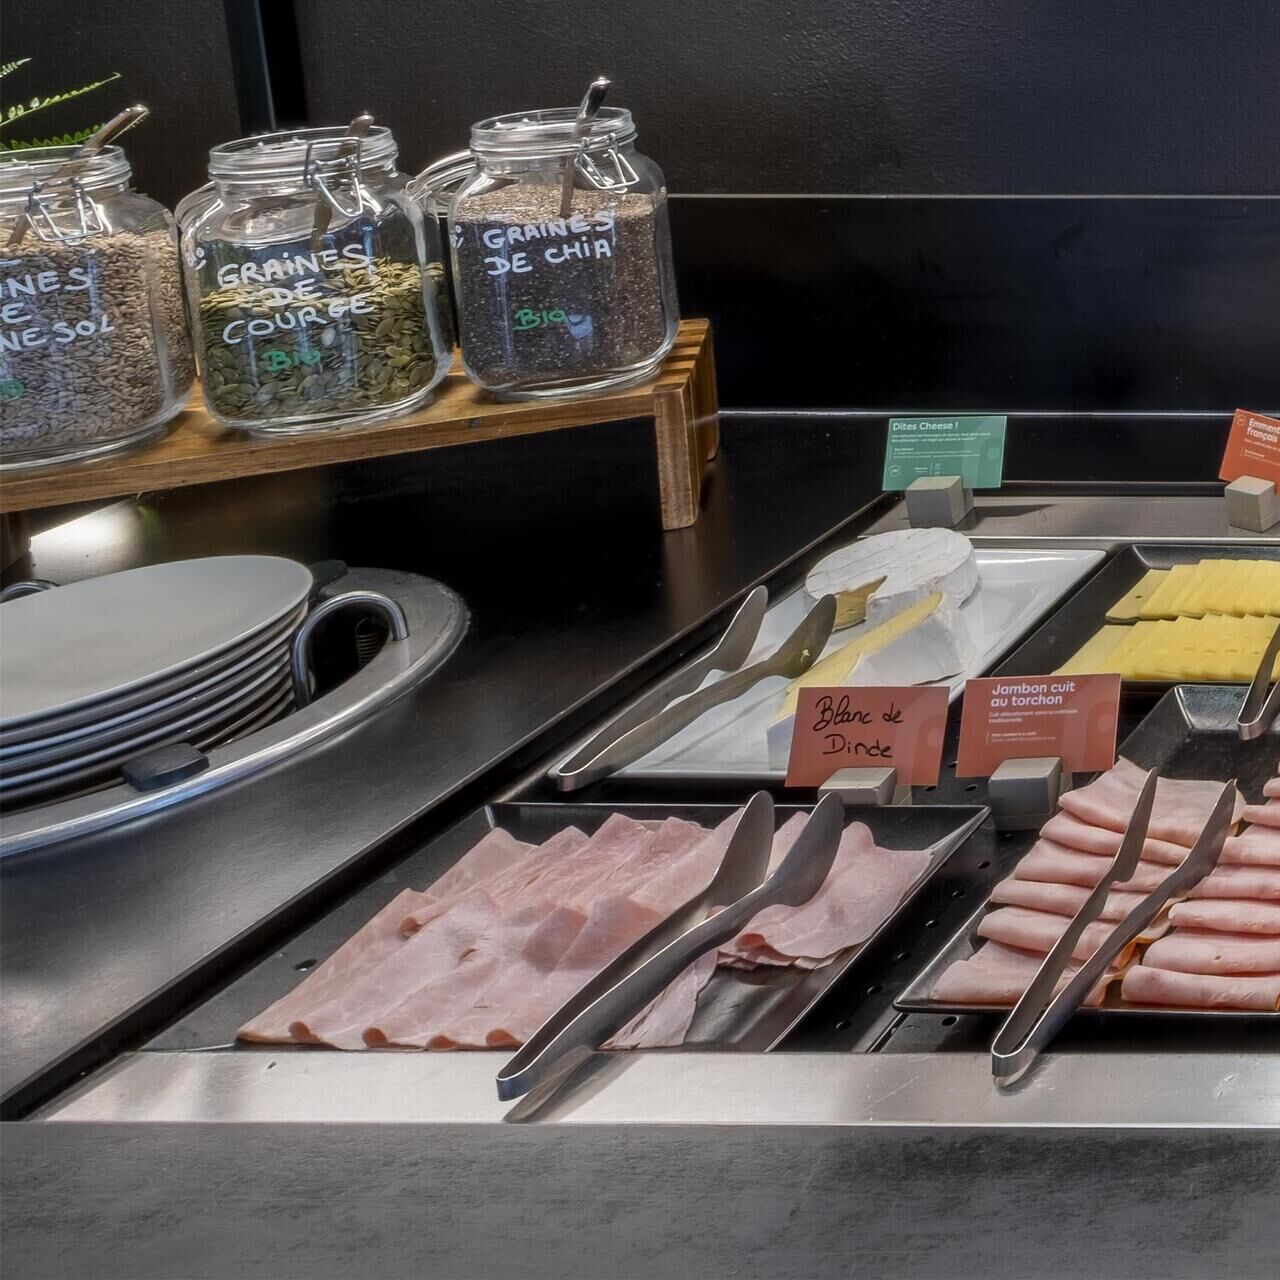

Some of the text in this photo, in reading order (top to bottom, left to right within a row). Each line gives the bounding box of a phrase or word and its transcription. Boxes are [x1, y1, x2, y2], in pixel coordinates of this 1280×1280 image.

[484, 252, 533, 276] DE
[259, 278, 323, 307] DE
[1, 302, 32, 324] E
[223, 291, 377, 345] COURGE
[892, 422, 917, 431] Dites
[919, 421, 953, 430] Cheese
[1246, 427, 1278, 443] français
[991, 681, 1076, 695] Jambon cuit
[991, 694, 1063, 707] au torchon
[812, 694, 905, 731] Blanc de
[822, 732, 894, 758] Dinde
